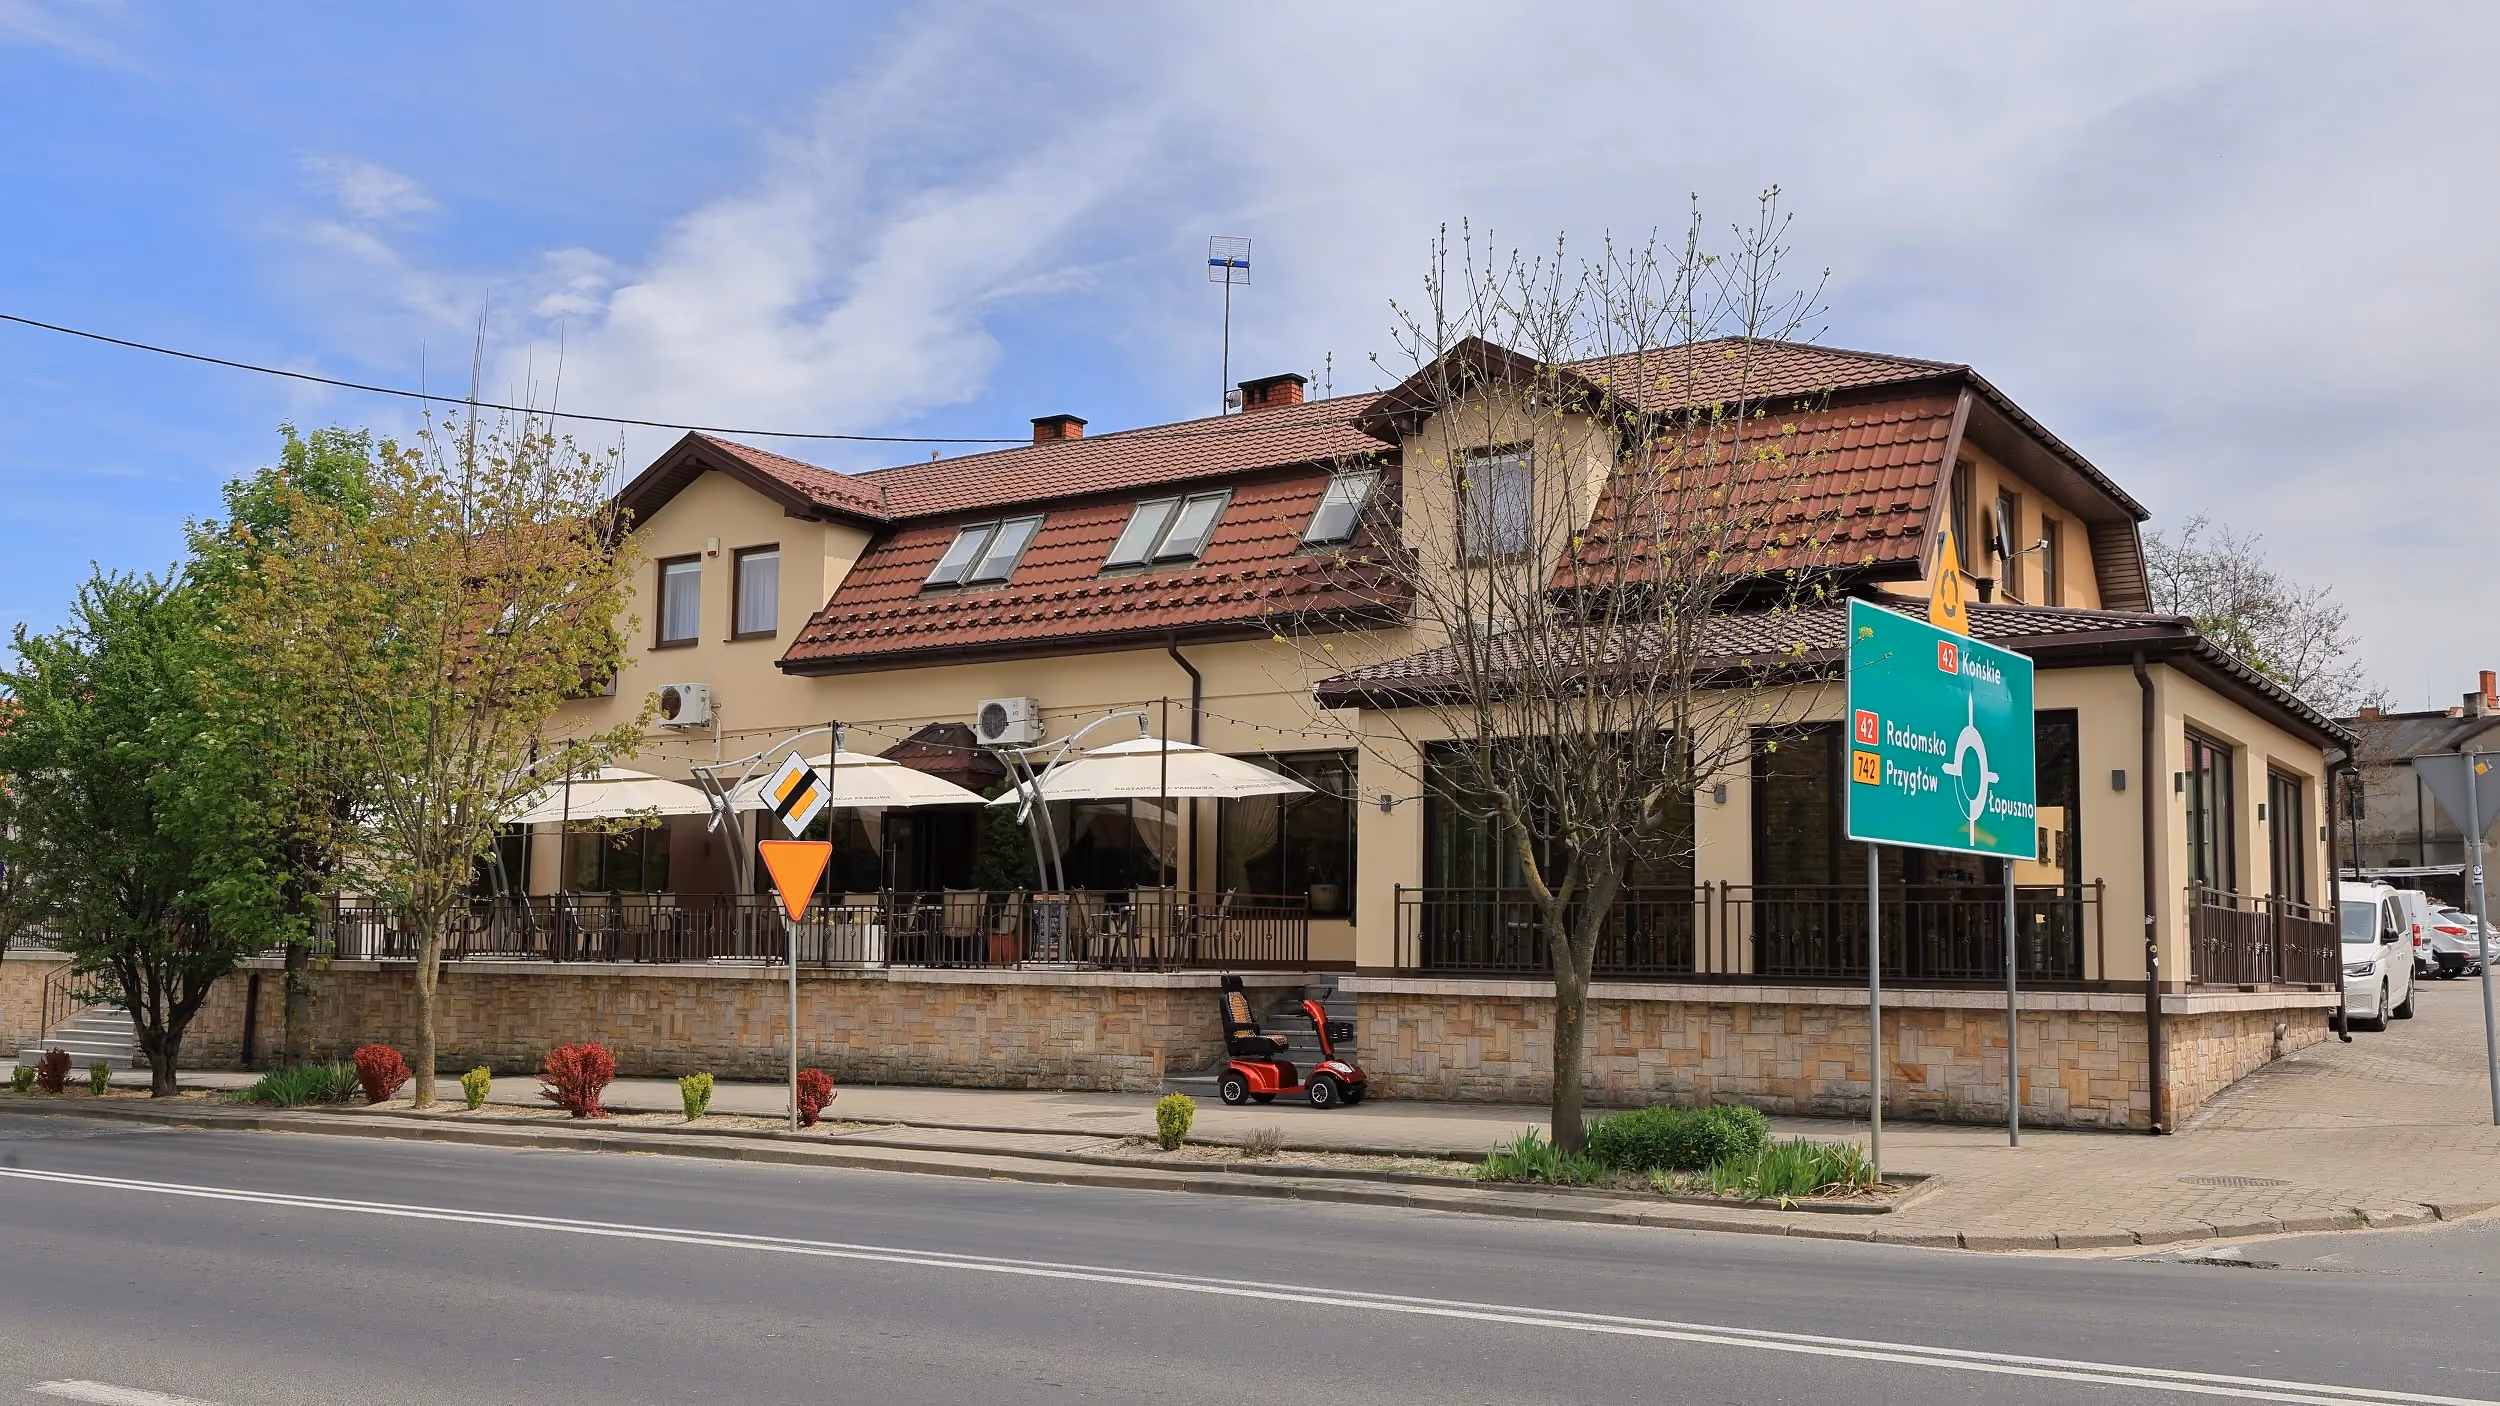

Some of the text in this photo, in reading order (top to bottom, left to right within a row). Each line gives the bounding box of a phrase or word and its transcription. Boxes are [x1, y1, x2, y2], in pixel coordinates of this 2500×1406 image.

[1942, 647, 2001, 685] 42 Końskie
[1860, 716, 1947, 757] 42 Radomsko
[1857, 756, 1938, 796] 742 Przygłów
[1988, 789, 2034, 822] Łopuszno
